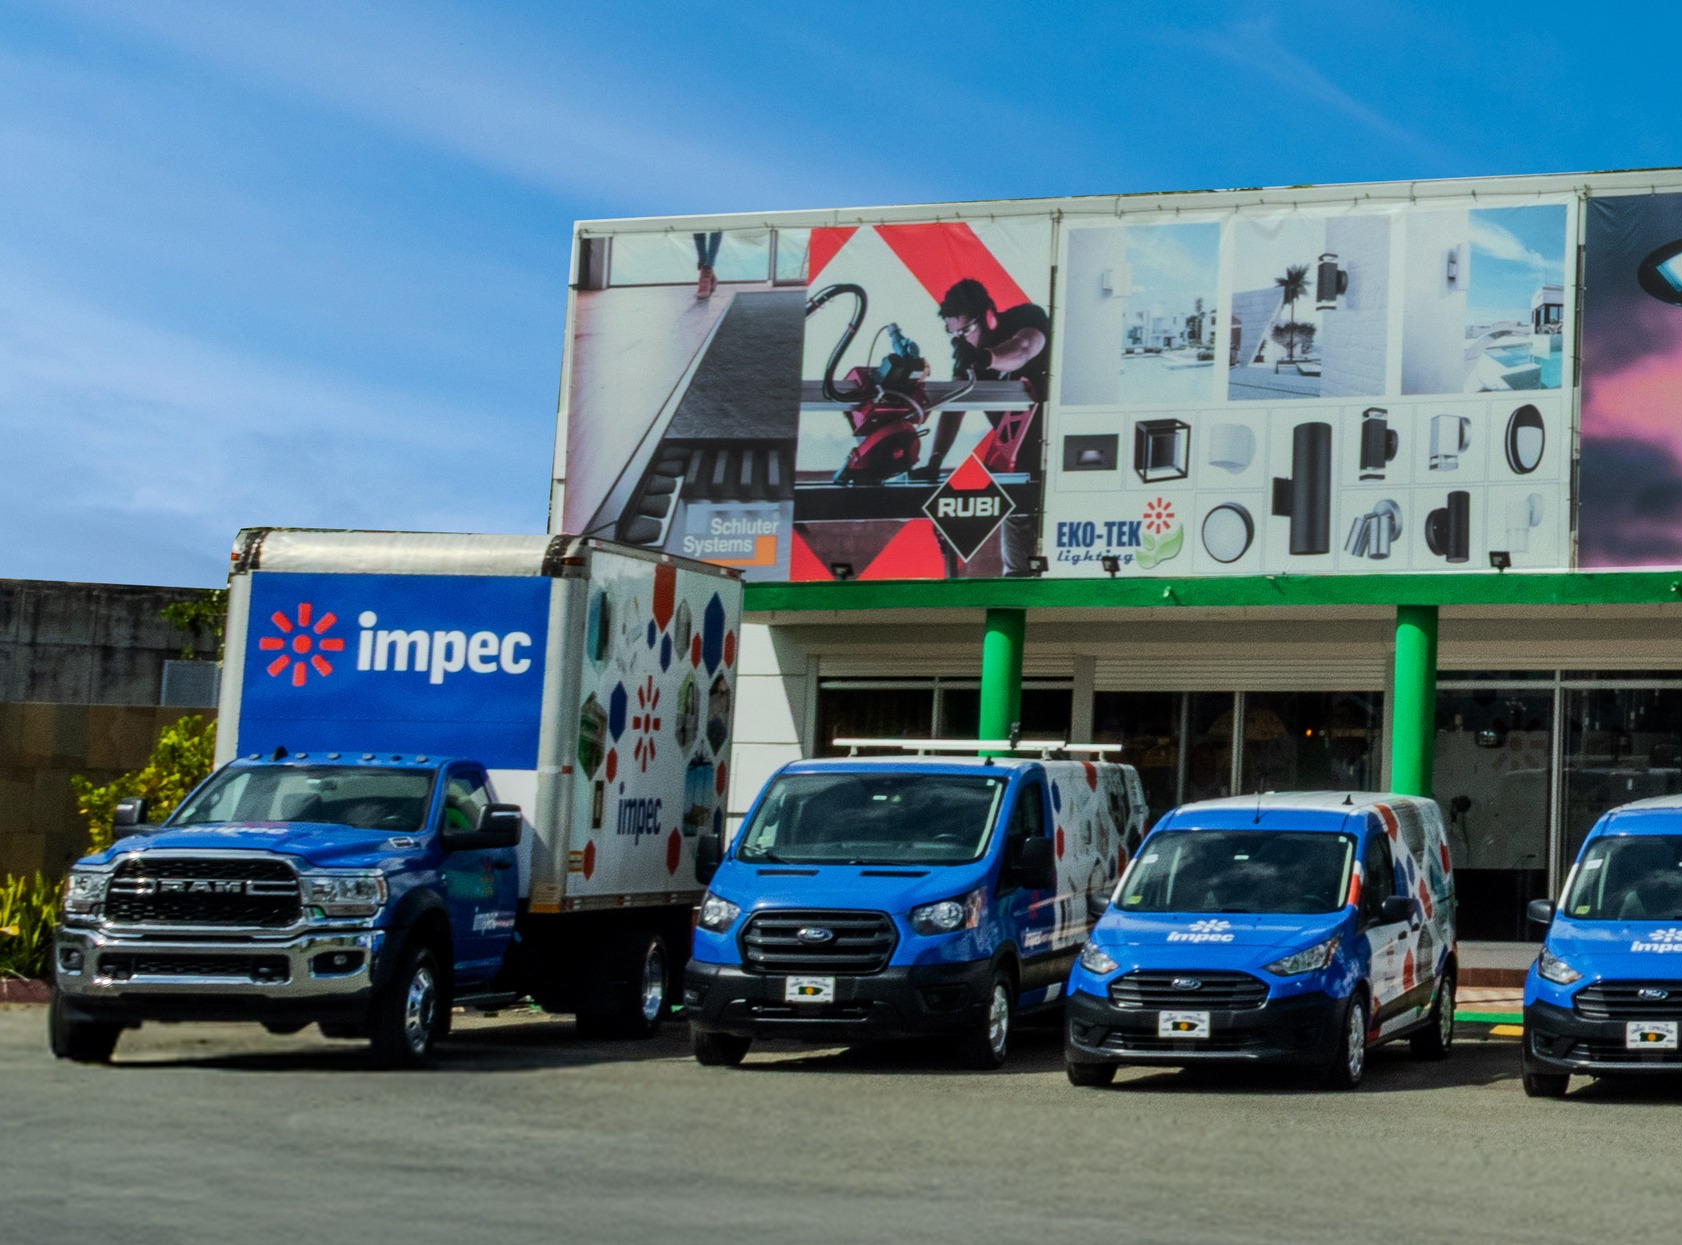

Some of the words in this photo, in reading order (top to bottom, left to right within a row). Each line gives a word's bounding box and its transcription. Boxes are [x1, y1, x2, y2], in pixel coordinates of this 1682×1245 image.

[937, 496, 1000, 518] RUBI
[711, 517, 779, 535] Schluter
[1056, 520, 1142, 548] EKO-TEK
[683, 535, 753, 557] Systems
[357, 610, 532, 685] impec
[617, 781, 662, 846] impec
[161, 880, 242, 893] RAM
[1166, 931, 1235, 944] impec
